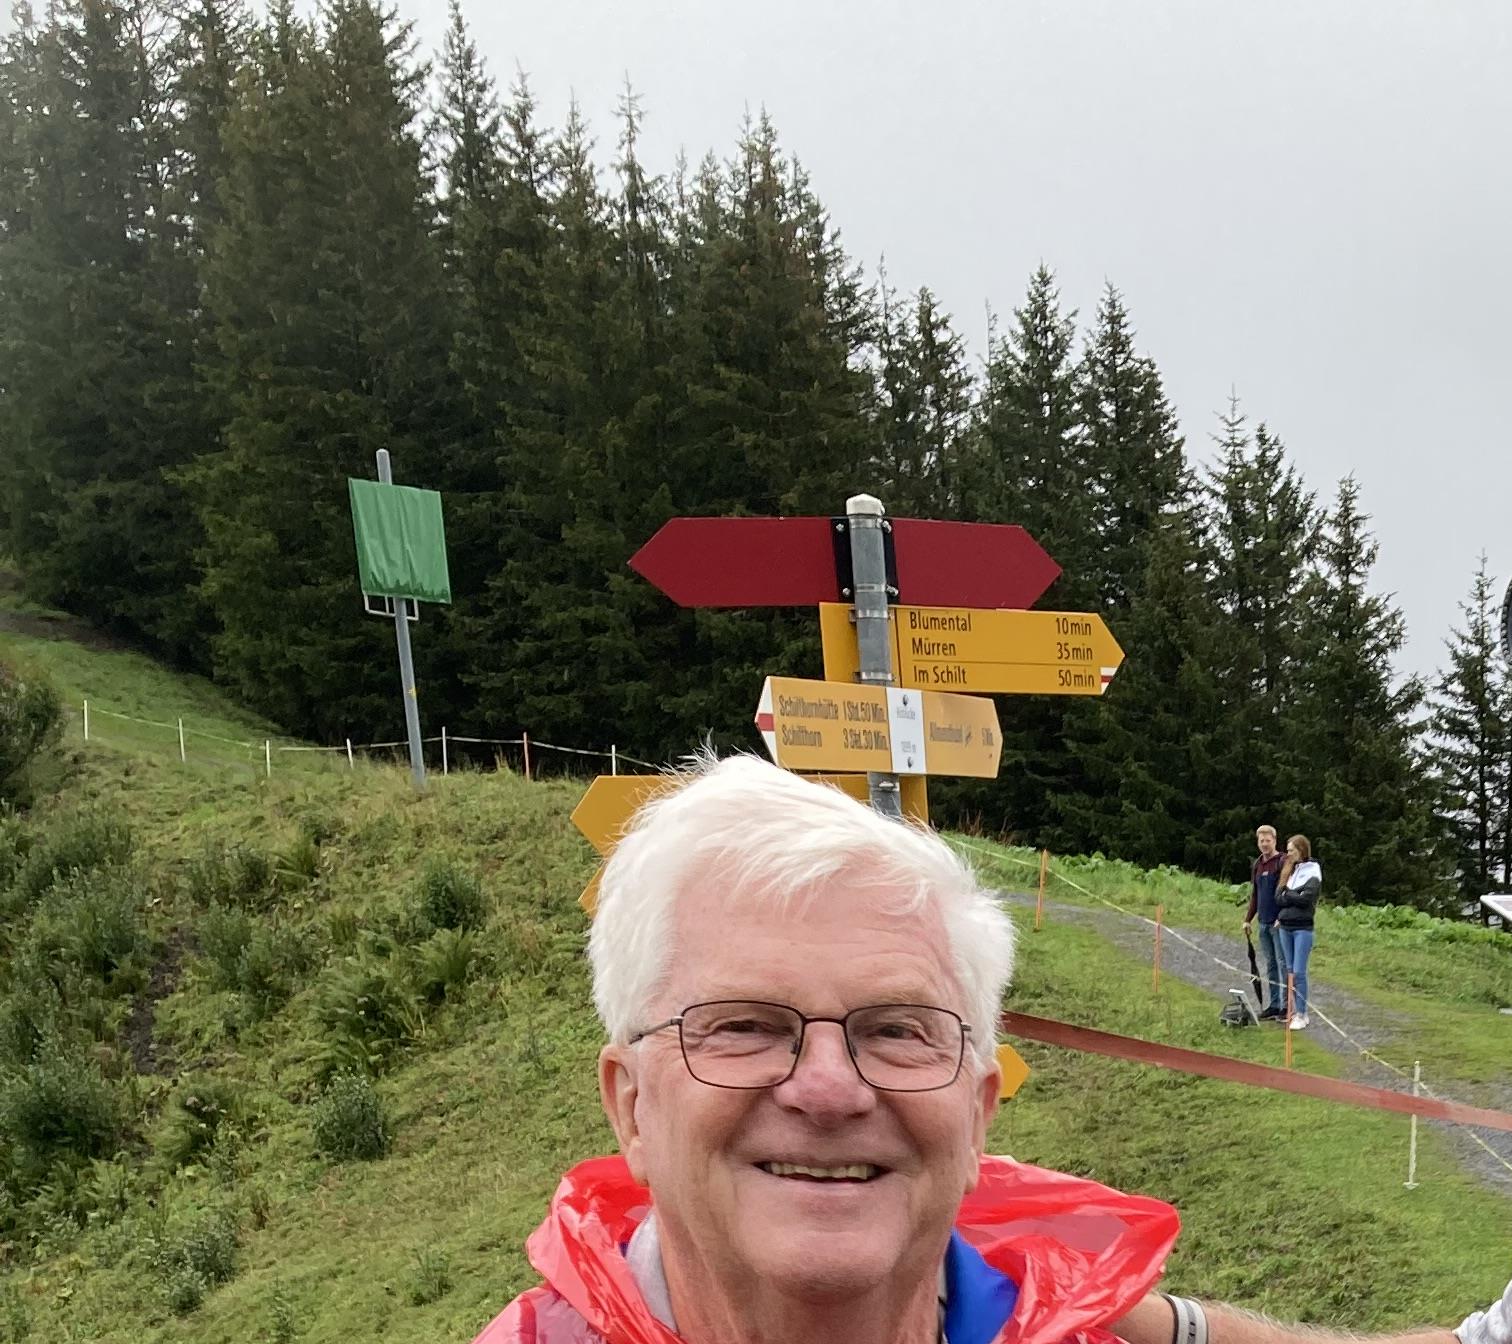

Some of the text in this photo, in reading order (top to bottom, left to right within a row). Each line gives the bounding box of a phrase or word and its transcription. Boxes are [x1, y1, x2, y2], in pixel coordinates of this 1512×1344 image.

[909, 611, 972, 632] Blumental
[911, 637, 957, 657] Mürren
[913, 665, 929, 684] Im
[933, 665, 968, 684] Schilt
